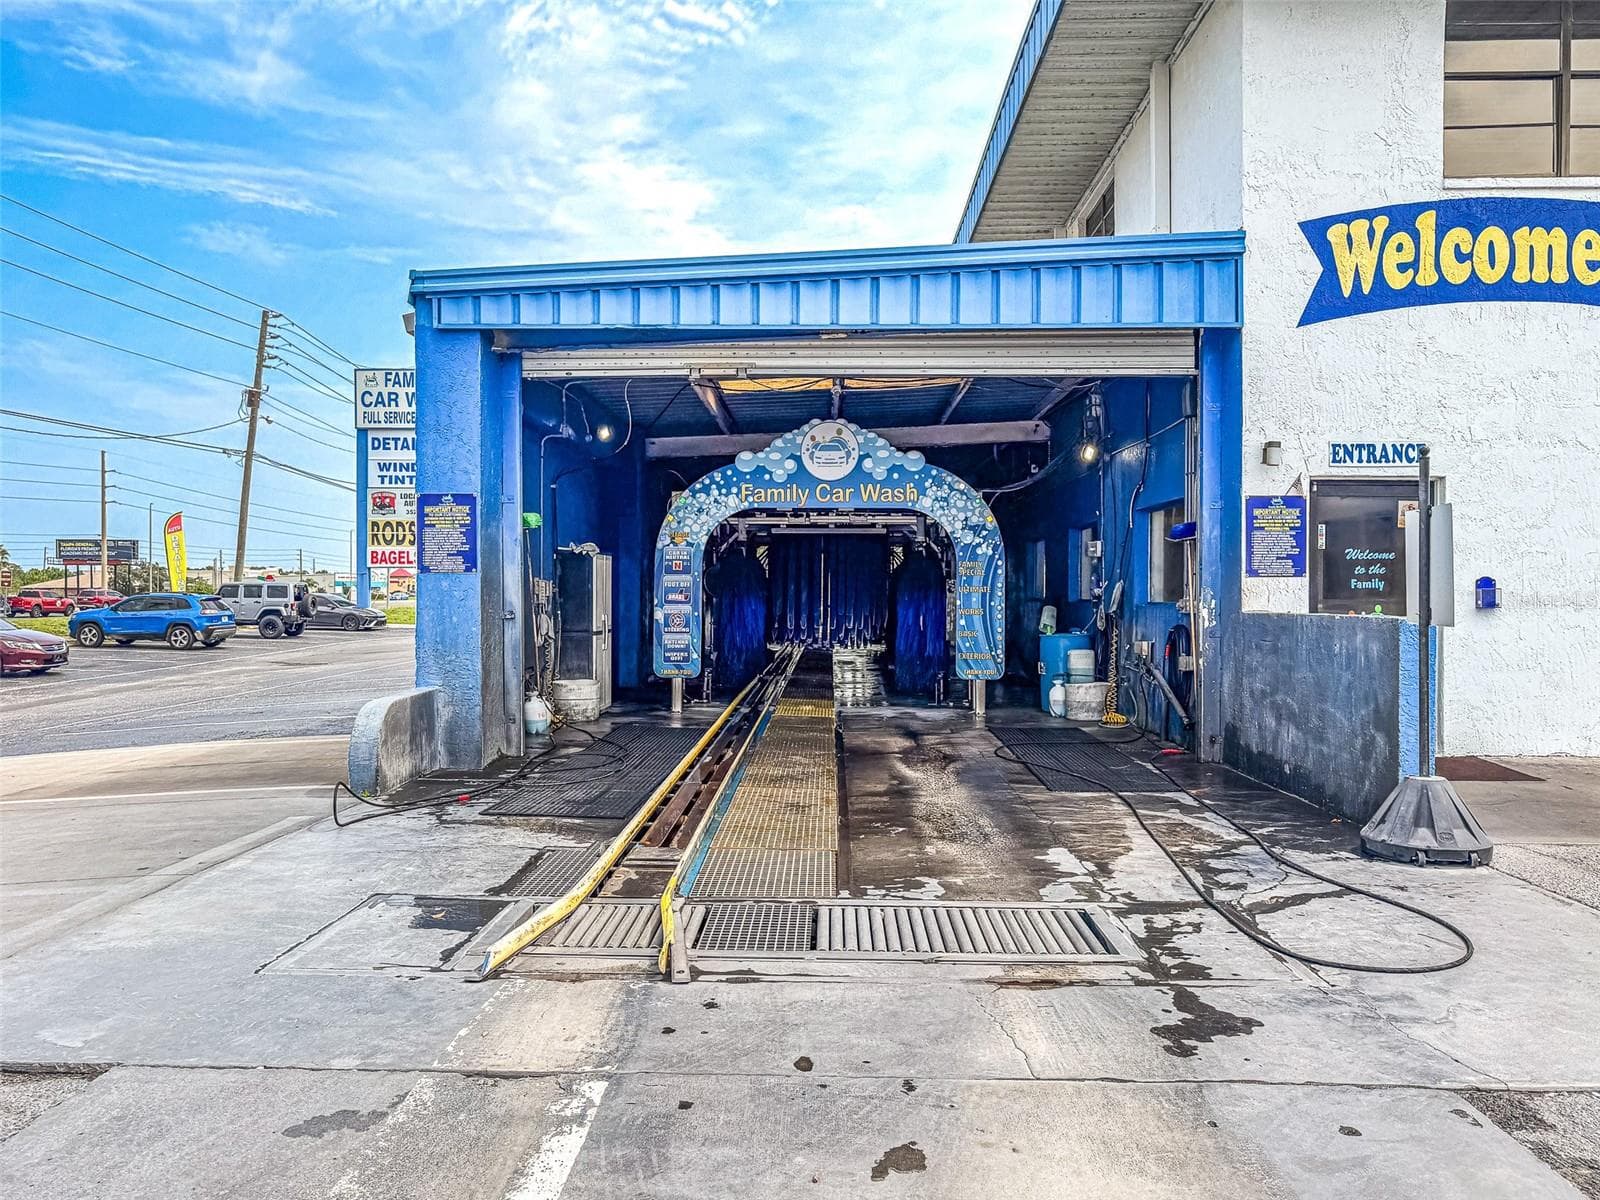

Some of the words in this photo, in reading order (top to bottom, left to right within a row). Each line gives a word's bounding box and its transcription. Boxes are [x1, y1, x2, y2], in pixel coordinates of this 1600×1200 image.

[1327, 209, 1600, 298] Welcome
[384, 371, 415, 388] FAM
[361, 390, 399, 408] CAR
[363, 411, 381, 424] FULL
[384, 411, 416, 424] SERVICE
[377, 474, 416, 485] TINT
[740, 482, 809, 508] Family
[815, 482, 854, 503] Car
[860, 482, 918, 503] Wash
[424, 505, 451, 513] IMPORTANT
[1253, 508, 1280, 516] IMPORTANT
[1281, 508, 1300, 516] NOTICE
[371, 521, 416, 546] ROD'S
[1345, 548, 1396, 560] Welcome
[1353, 563, 1367, 575] to
[1368, 561, 1387, 575] the
[1350, 578, 1385, 592] Family
[959, 608, 985, 616] WORKS
